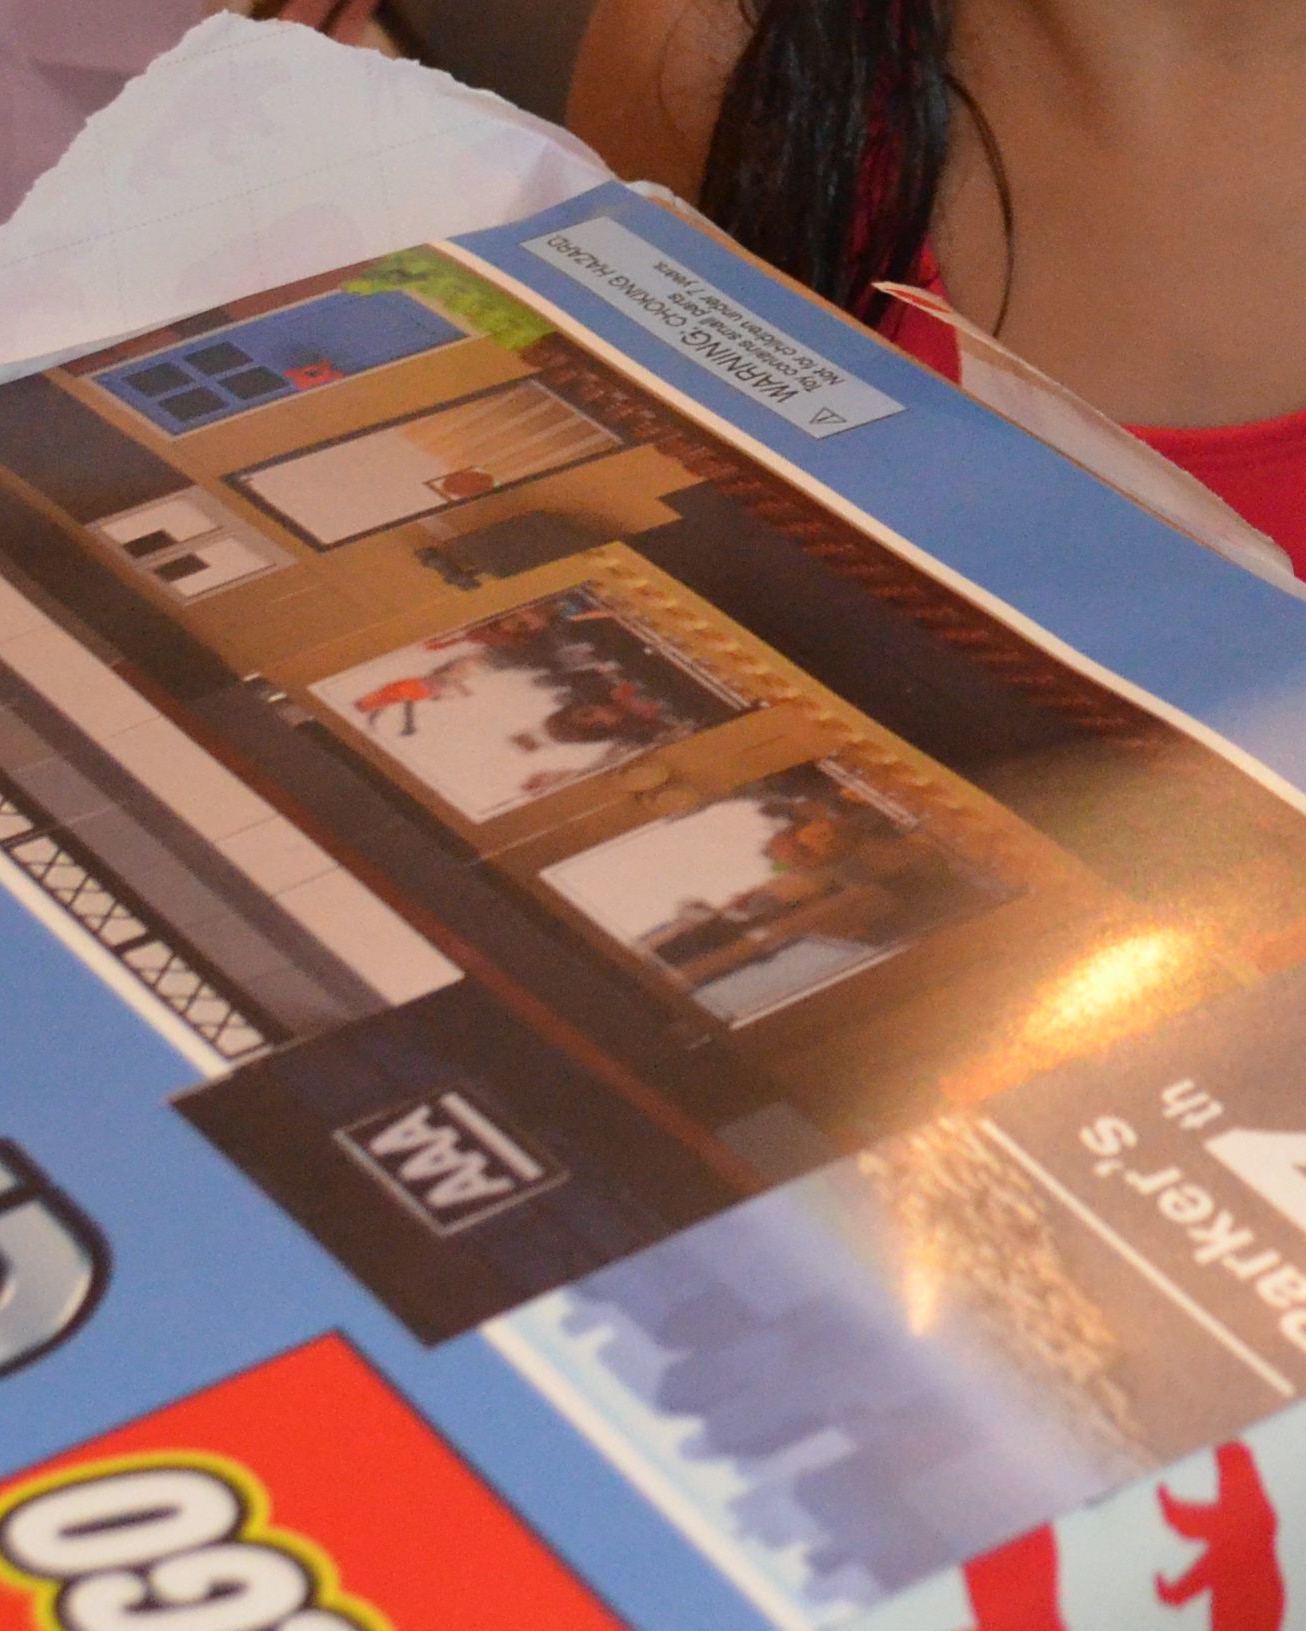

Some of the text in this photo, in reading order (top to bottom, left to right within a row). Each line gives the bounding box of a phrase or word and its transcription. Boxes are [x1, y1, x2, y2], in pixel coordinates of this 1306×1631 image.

[608, 275, 686, 326] CHOKING
[699, 295, 742, 321] under
[667, 292, 821, 392] Toy contains small parts
[740, 321, 796, 355] children
[792, 356, 817, 369] for
[812, 367, 844, 385] Not
[370, 1104, 514, 1208] AAA
